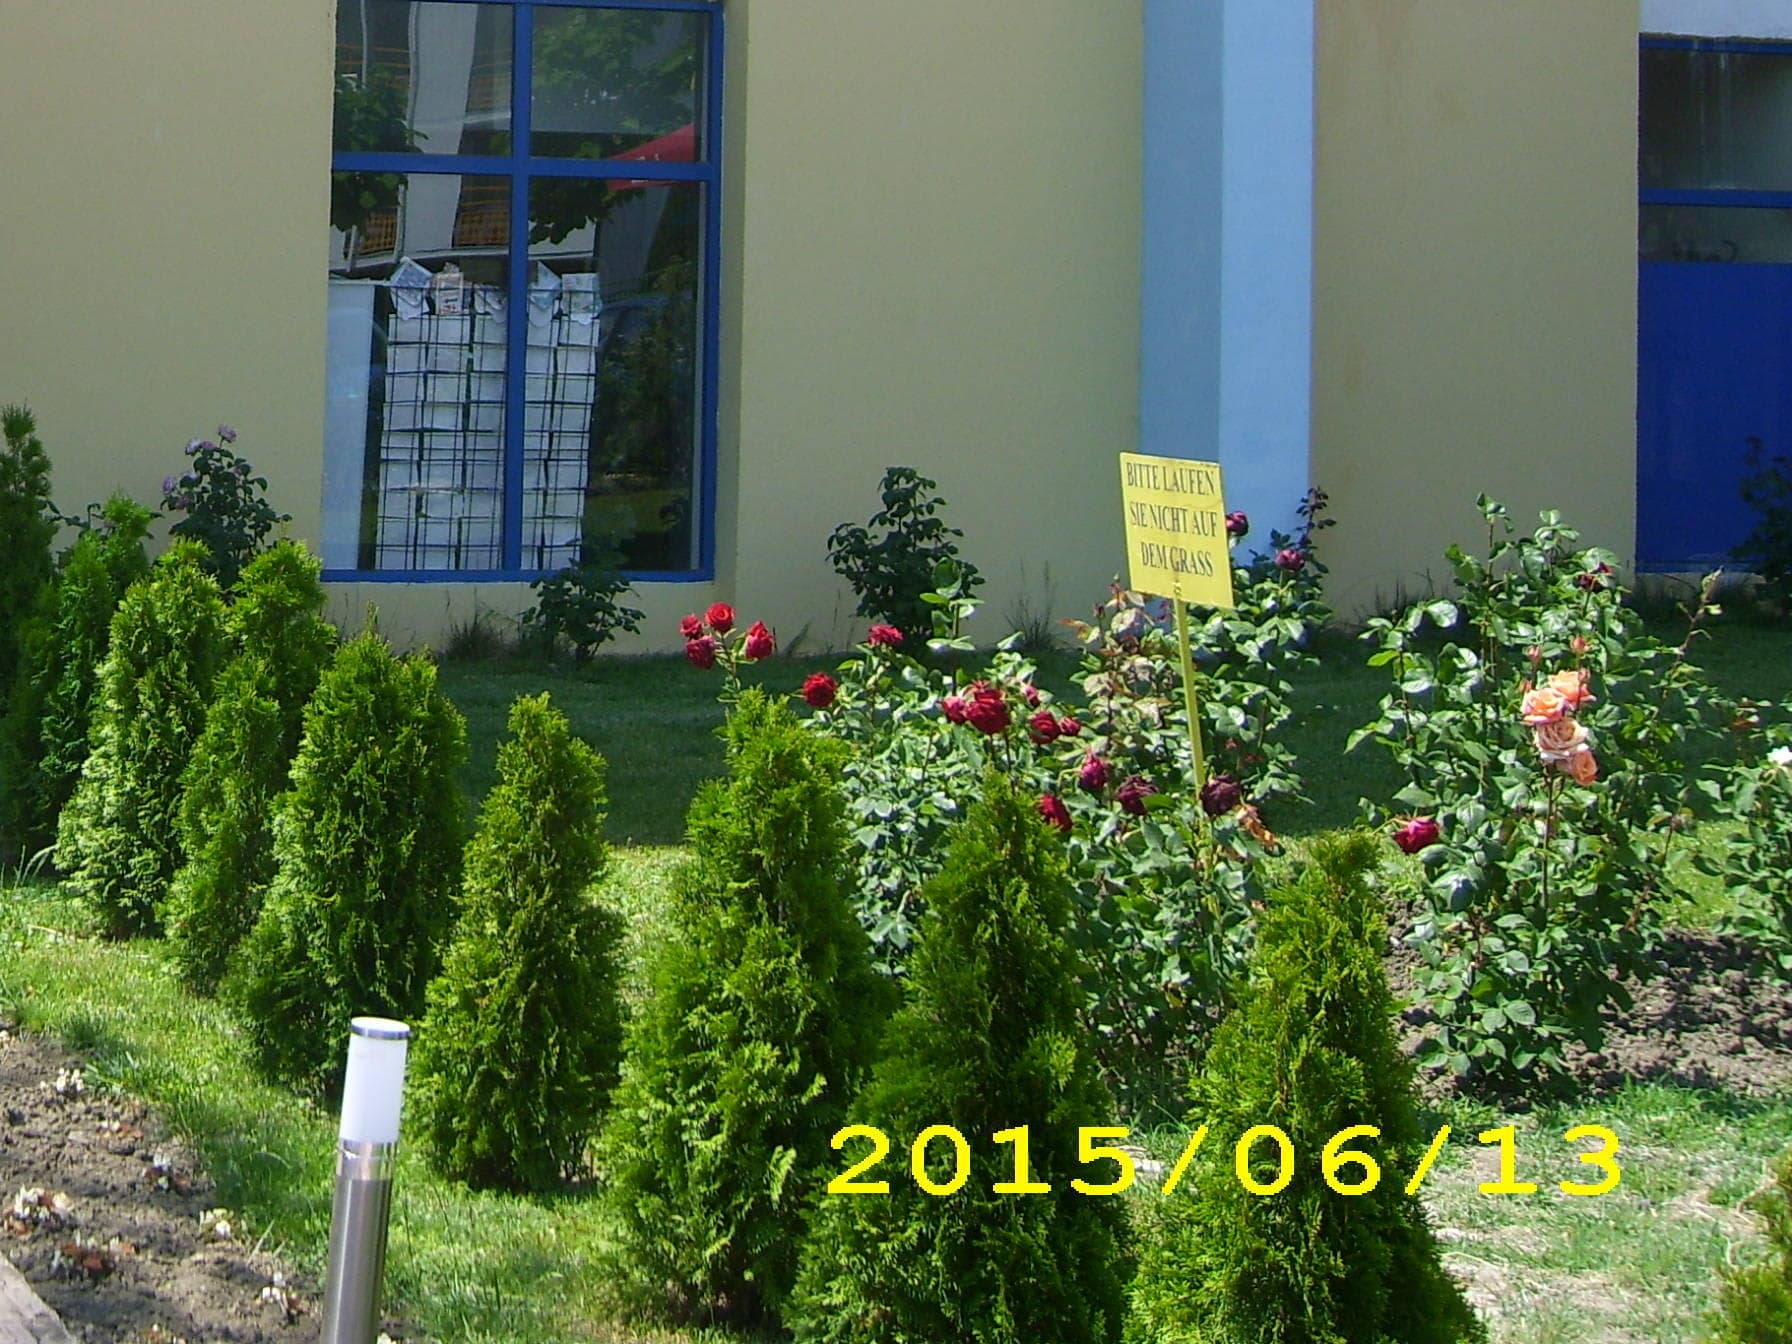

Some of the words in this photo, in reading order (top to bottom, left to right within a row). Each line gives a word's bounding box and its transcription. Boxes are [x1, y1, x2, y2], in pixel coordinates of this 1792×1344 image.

[1126, 462, 1161, 491] BITTE
[1162, 466, 1216, 496] LAUFEN
[1129, 501, 1148, 528] SIE
[1149, 503, 1188, 533] NICHT
[1192, 511, 1217, 537] AUF
[1140, 541, 1169, 570] DEM
[1169, 546, 1214, 577] GRASS
